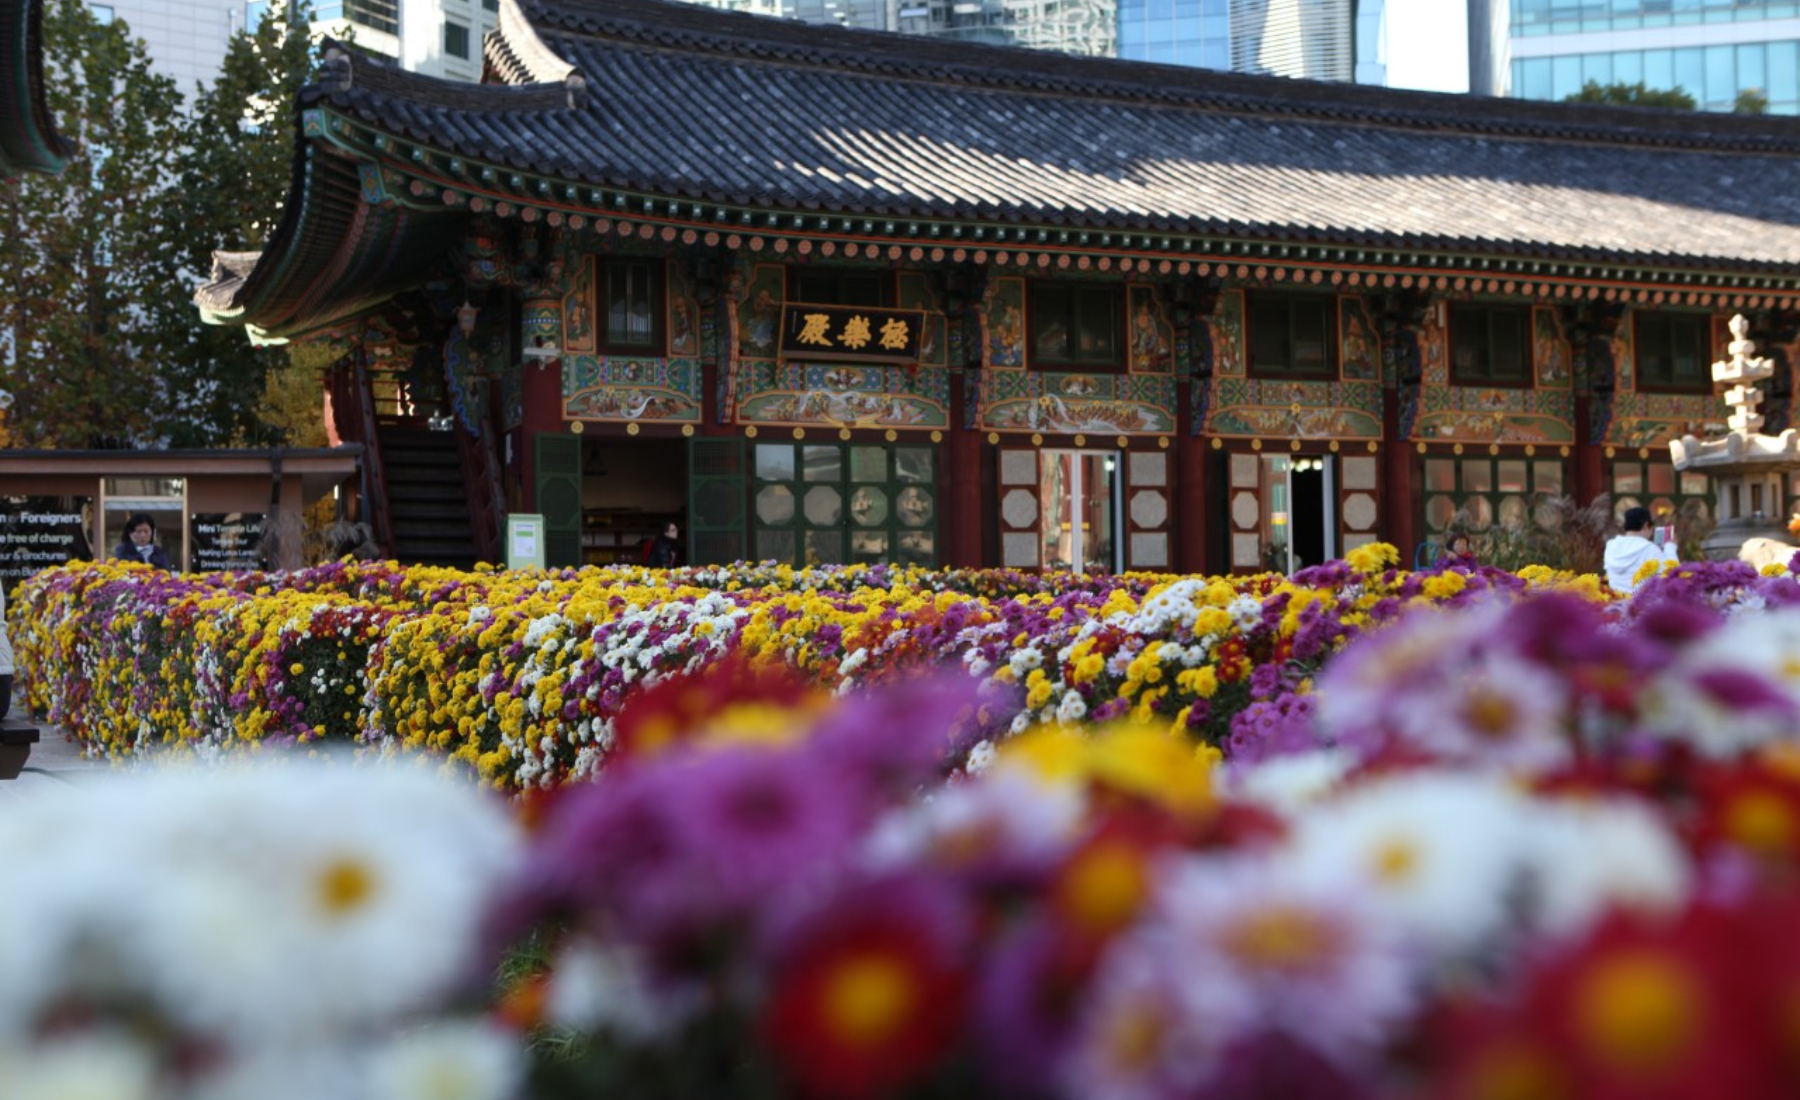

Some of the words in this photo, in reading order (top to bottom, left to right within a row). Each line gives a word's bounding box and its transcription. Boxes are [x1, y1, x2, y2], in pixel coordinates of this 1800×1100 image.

[20, 511, 82, 526] Foreigners
[198, 524, 216, 534] Mini
[7, 533, 28, 543] free
[29, 533, 39, 543] of
[40, 533, 74, 545] charge
